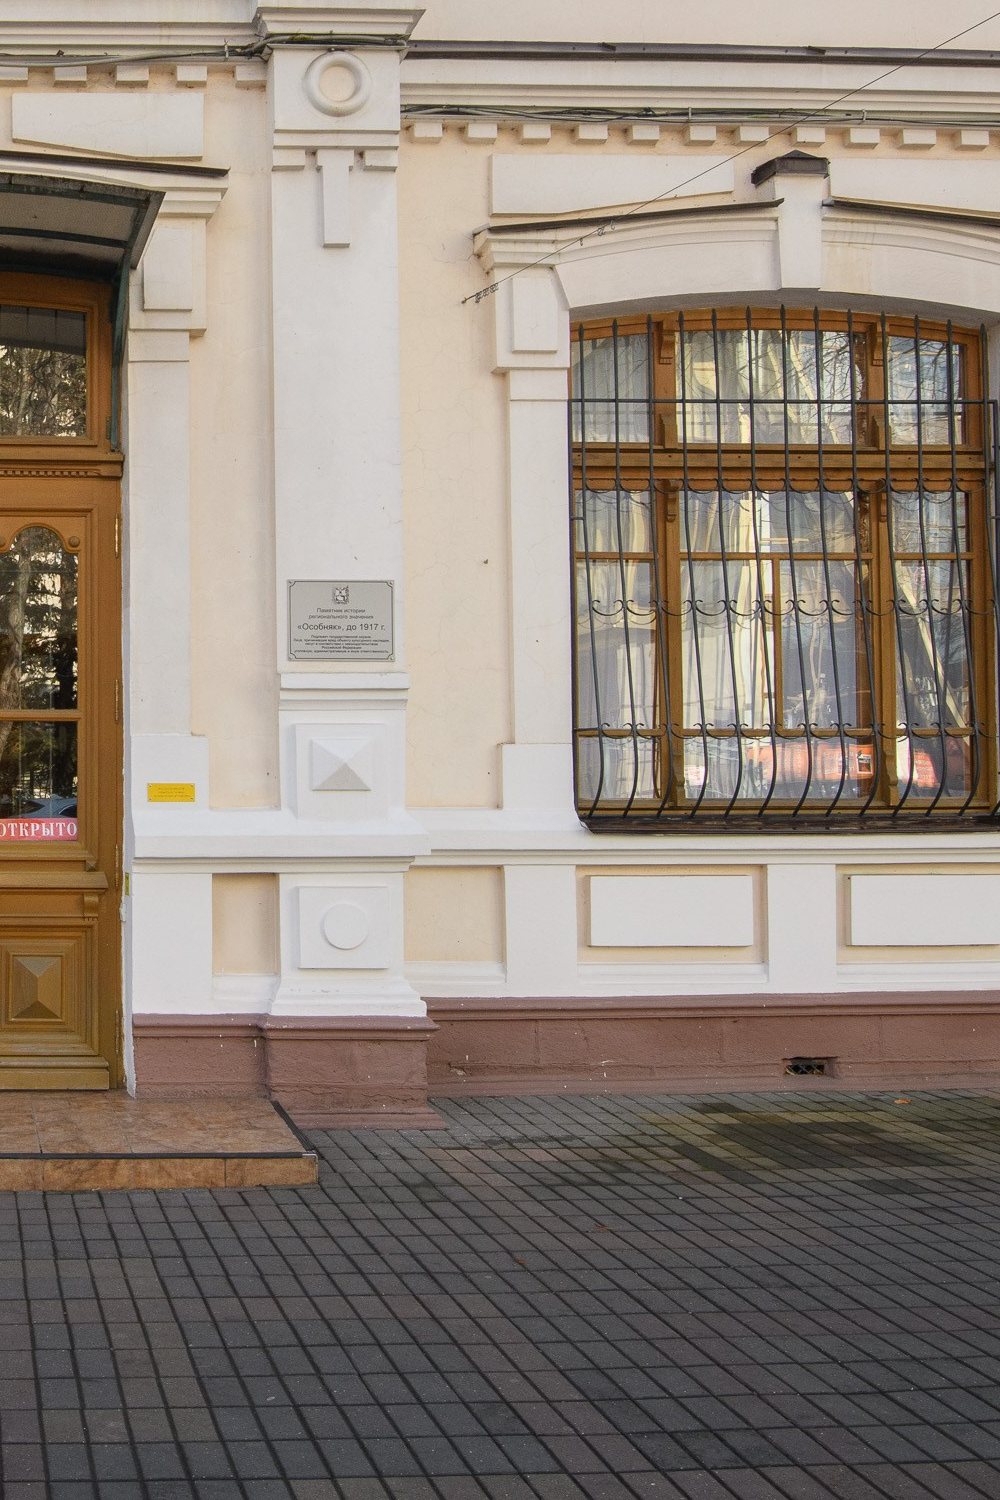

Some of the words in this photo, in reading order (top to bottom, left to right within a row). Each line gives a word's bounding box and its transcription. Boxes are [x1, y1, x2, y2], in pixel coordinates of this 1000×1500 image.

[297, 622, 345, 631] «Особняк»,
[345, 624, 357, 632] до
[359, 623, 379, 631] 1917
